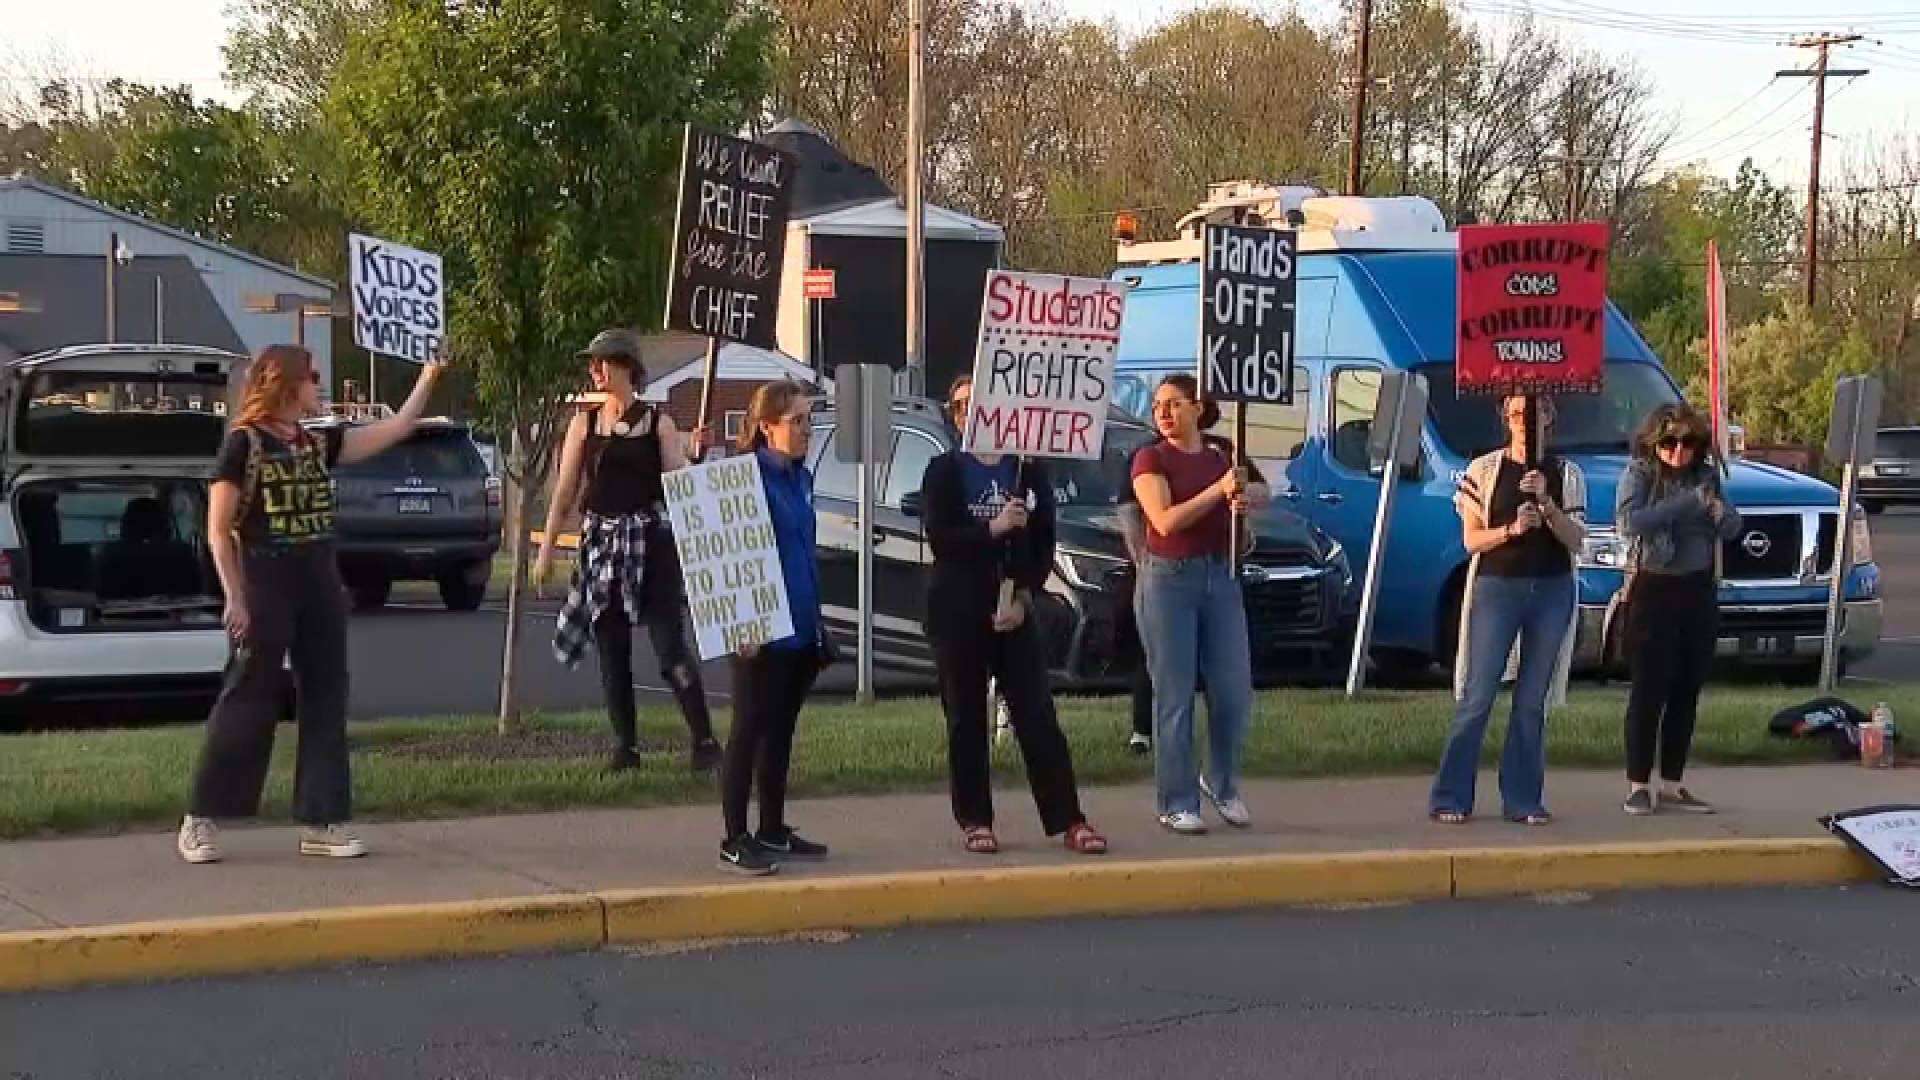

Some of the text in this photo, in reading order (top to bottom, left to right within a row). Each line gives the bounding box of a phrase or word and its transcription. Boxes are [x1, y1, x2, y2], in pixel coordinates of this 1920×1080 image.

[699, 179, 774, 241] RELIEF
[731, 239, 769, 280] the
[1207, 227, 1292, 279] Hands
[1461, 238, 1599, 273] CORRUPT
[690, 285, 758, 340] CHIEF
[988, 275, 1120, 331] Students
[1460, 304, 1603, 341] CORRUPT
[1206, 331, 1290, 403] Kids!
[1493, 339, 1565, 363] TOWNS
[989, 349, 1105, 401] RIGHTS
[970, 405, 1093, 453] MATTER
[663, 460, 755, 503] NO SIGN
[682, 491, 758, 533] IS BIG
[679, 522, 774, 565] ENOUGH
[685, 556, 767, 597] TO LIST
[693, 592, 737, 628] WHY
